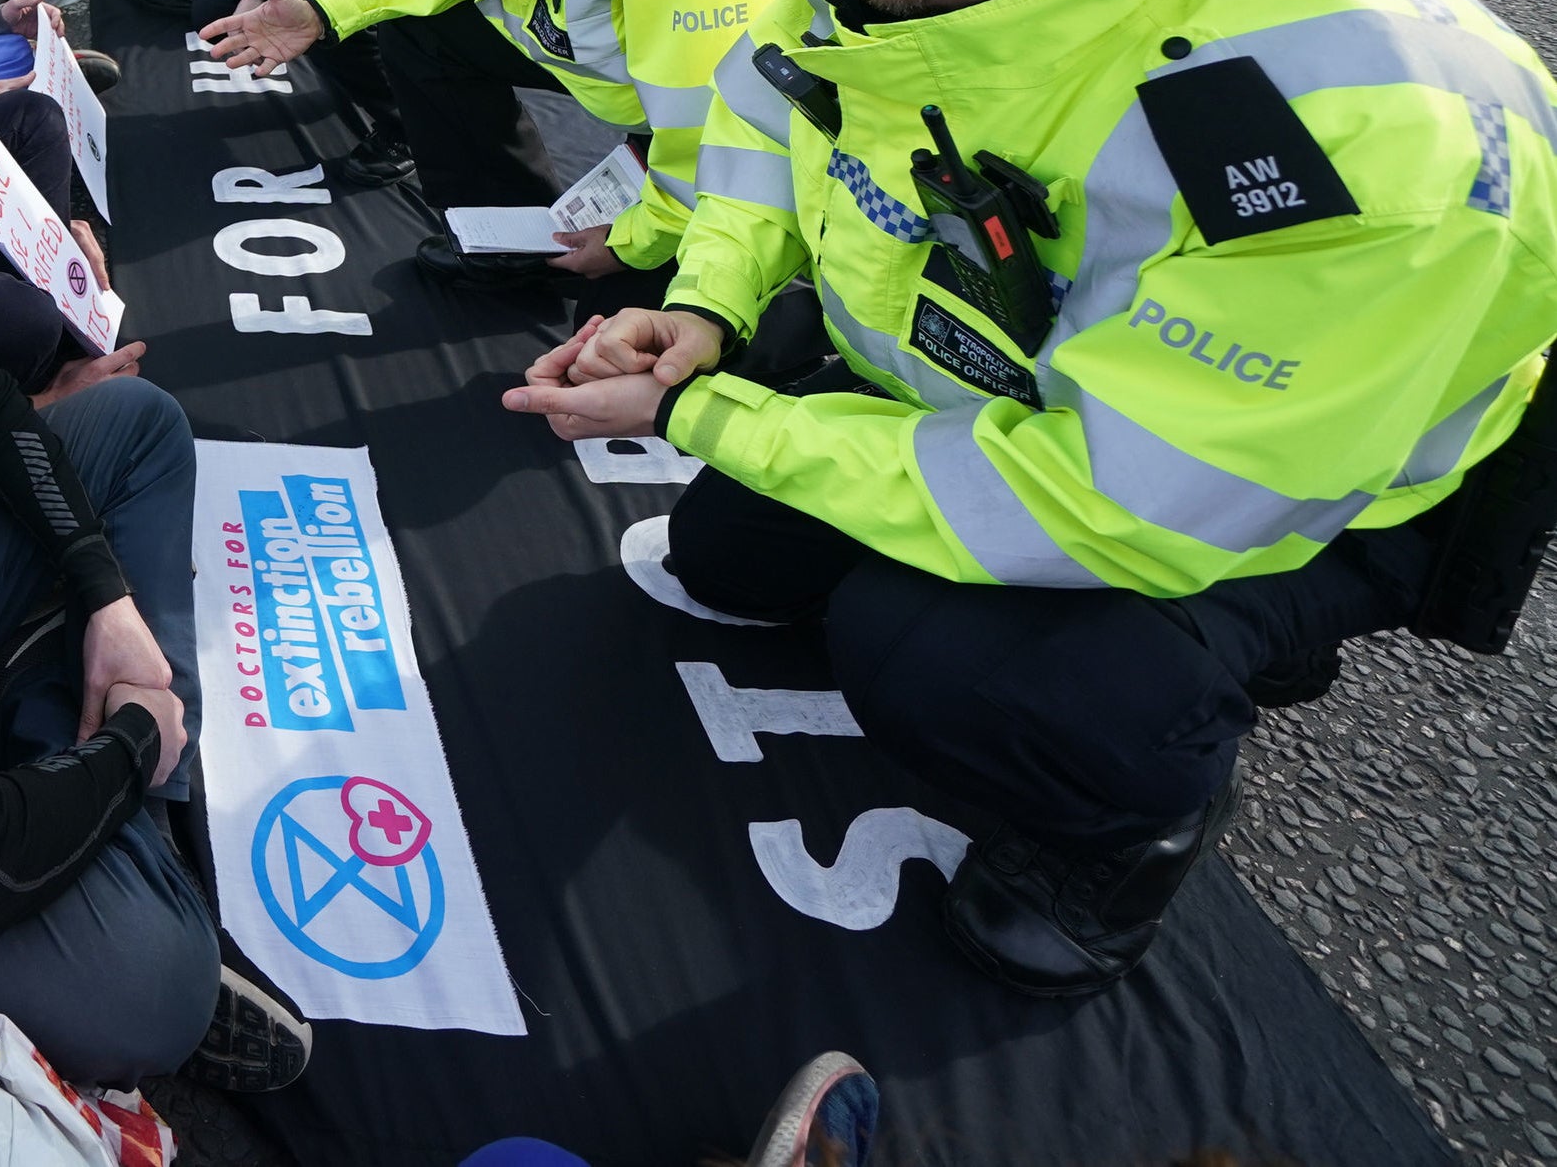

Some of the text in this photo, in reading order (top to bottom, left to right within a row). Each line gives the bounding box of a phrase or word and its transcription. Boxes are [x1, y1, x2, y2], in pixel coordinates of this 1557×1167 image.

[672, 2, 749, 33] POLICE
[1223, 155, 1281, 190] AW
[1230, 181, 1307, 217] 3912
[35, 217, 63, 291] RIFIED
[211, 162, 374, 336] FOR
[918, 331, 1031, 400] POLICE OFFICER
[954, 329, 1019, 378] METROPOLITAN
[959, 344, 1008, 381] POLICE
[1128, 297, 1302, 391] POLICE
[298, 482, 387, 652] rebellion
[222, 521, 268, 728] DOCTORS FOR
[254, 516, 333, 718] extinction
